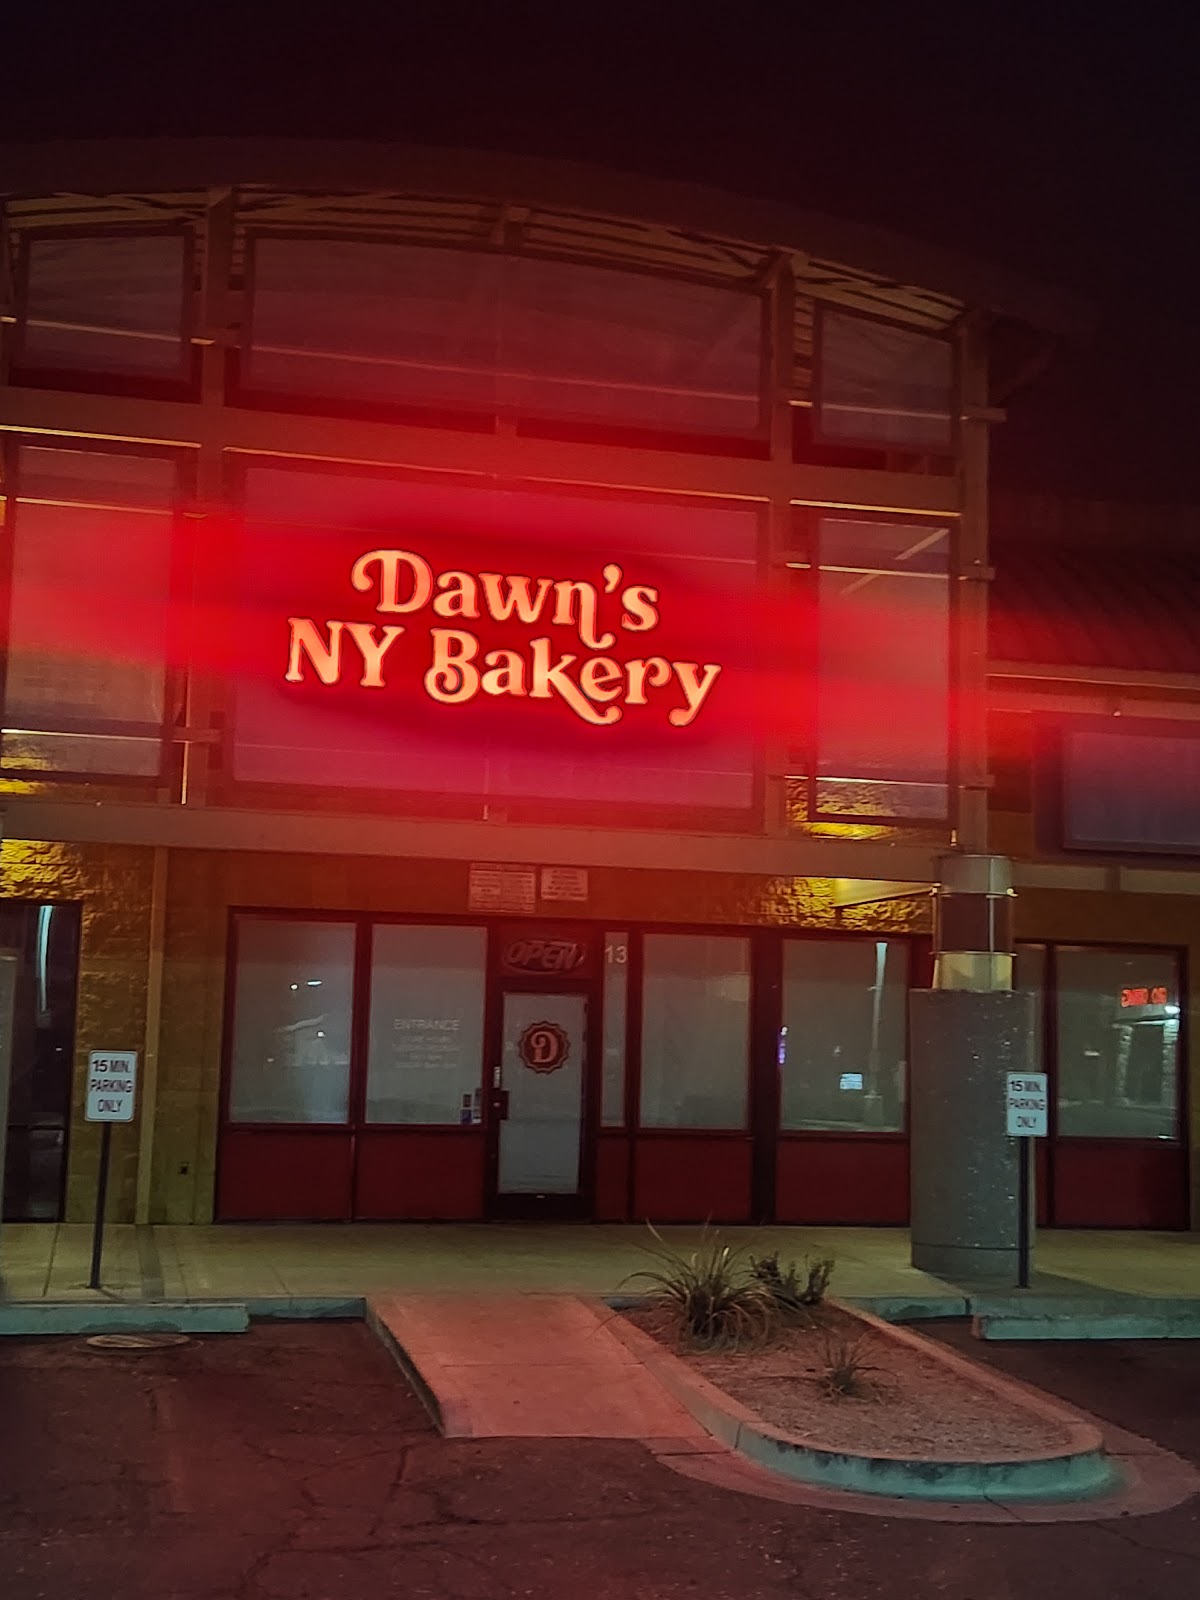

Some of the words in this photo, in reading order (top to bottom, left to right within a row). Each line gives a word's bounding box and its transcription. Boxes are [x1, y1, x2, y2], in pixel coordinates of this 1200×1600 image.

[352, 549, 659, 650] Dawn's
[285, 617, 405, 688] NY
[425, 628, 722, 727] Bakery
[508, 940, 578, 970] OPEN
[605, 945, 627, 964] 13
[394, 1018, 461, 1031] ENTRANCE
[92, 1060, 108, 1072] 15
[90, 1079, 133, 1093] PARKING
[1010, 1080, 1023, 1092] 15
[98, 1099, 122, 1112] ONLY
